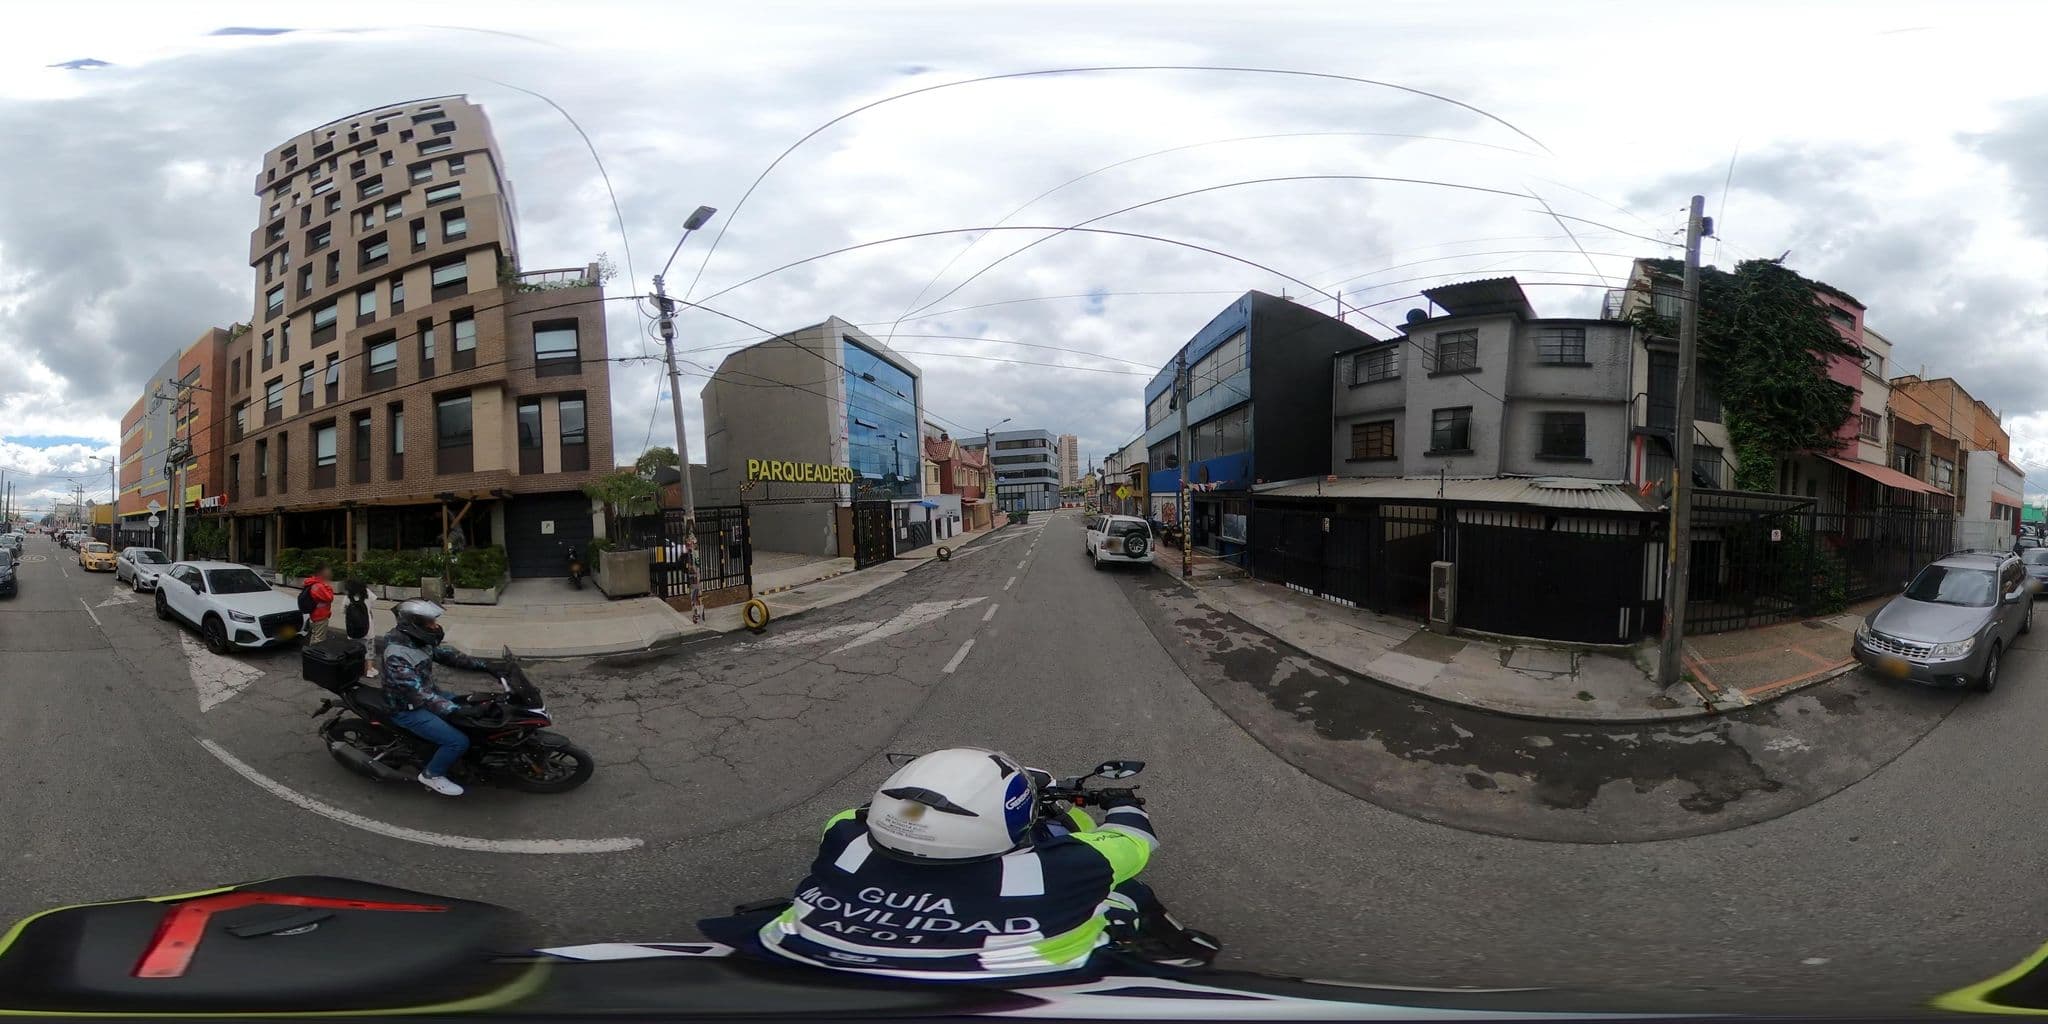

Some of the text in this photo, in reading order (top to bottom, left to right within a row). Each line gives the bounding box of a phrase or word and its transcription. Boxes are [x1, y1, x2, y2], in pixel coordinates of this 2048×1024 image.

[748, 459, 854, 483] PARQUEADERO
[800, 886, 1040, 934] MOVILIDAD
[858, 887, 955, 914] GUÍA
